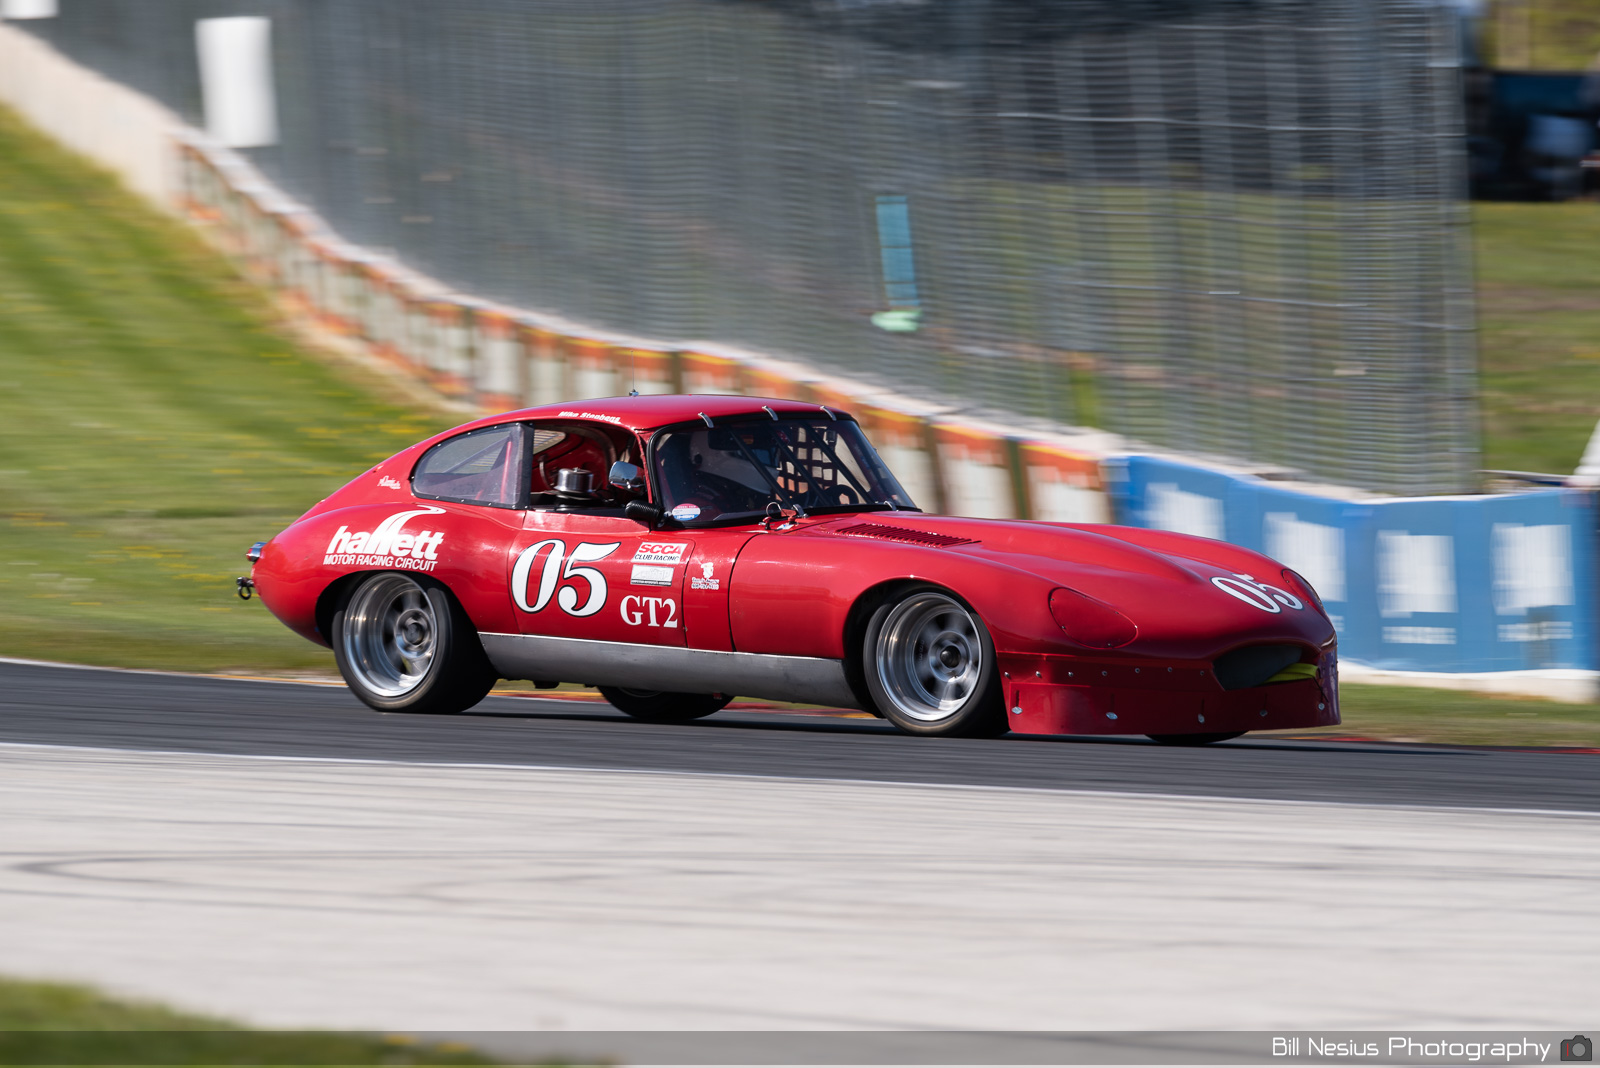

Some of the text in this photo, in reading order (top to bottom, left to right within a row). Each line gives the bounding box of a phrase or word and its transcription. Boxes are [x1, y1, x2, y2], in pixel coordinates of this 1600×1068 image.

[326, 522, 445, 560] hallett
[639, 544, 681, 554] SCCA
[323, 554, 438, 571] MOTOR RACING CIRCUIT
[511, 539, 621, 618] 05
[1209, 572, 1304, 614] 05
[620, 595, 678, 628] GT2
